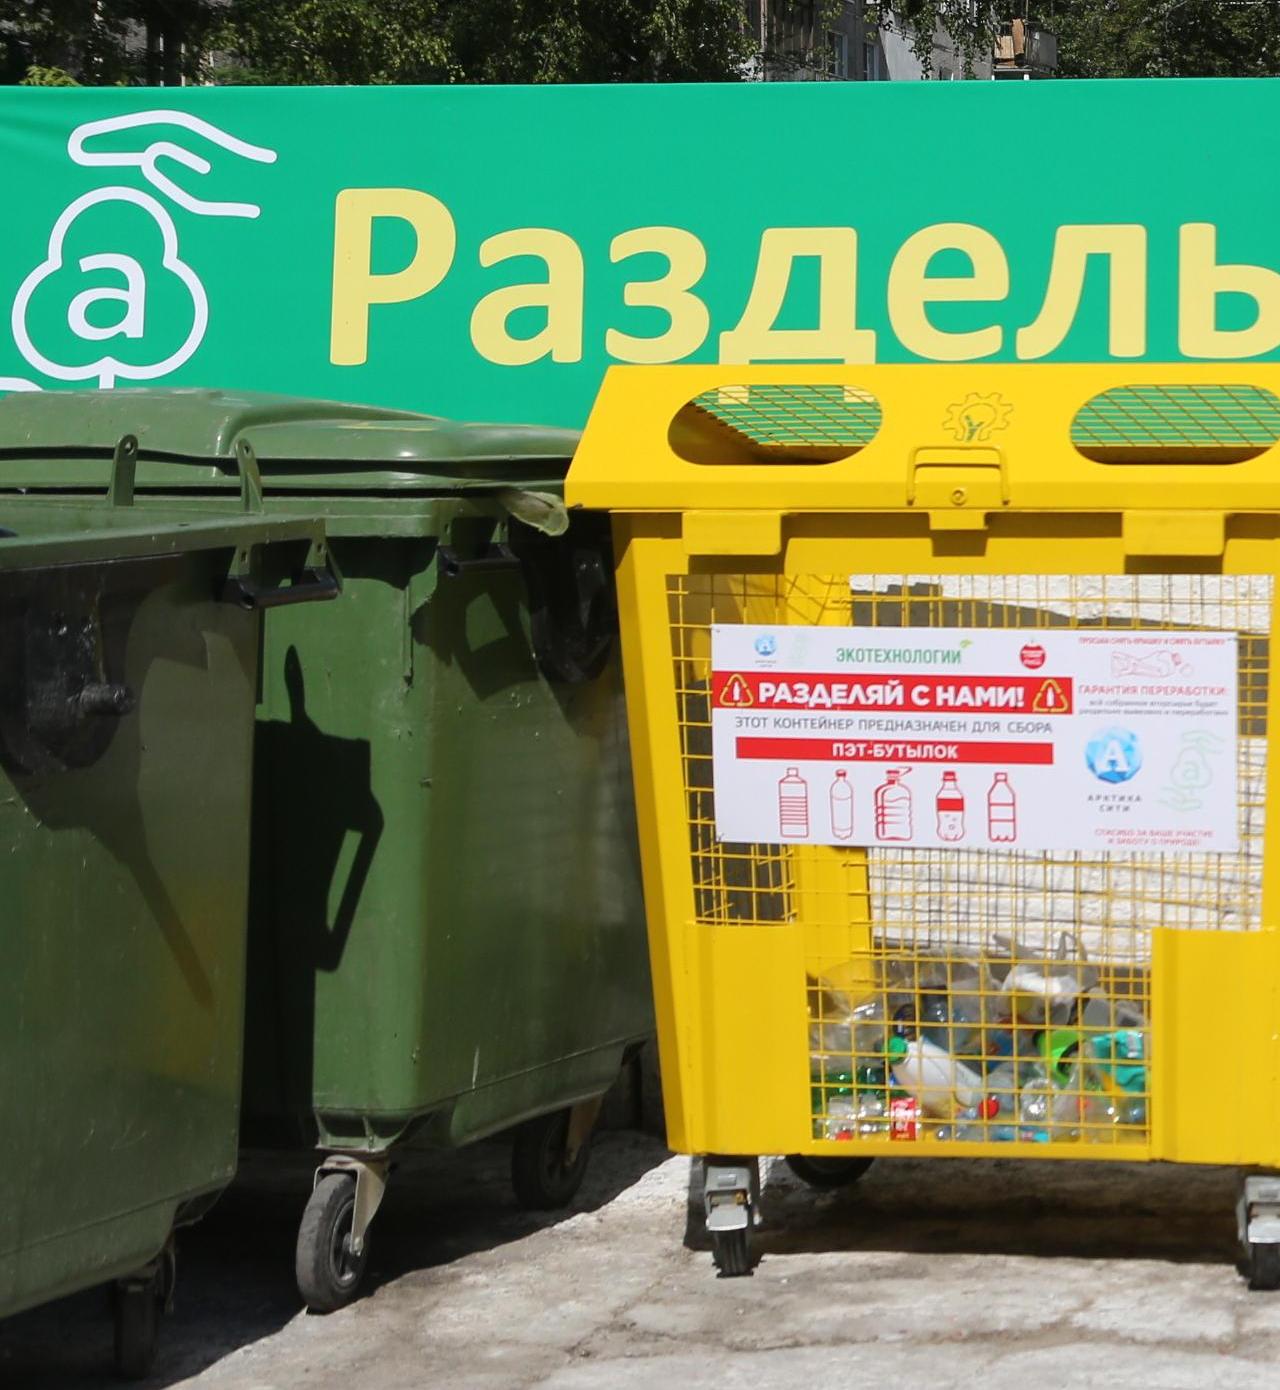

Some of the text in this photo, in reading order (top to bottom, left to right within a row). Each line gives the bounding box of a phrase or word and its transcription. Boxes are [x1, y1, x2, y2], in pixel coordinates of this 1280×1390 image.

[836, 647, 962, 664] ЭКОТЕХНОЛОГИИ
[758, 680, 1025, 709] РАЗДЕЛЯЙ С НАМИ!
[1078, 685, 1137, 695] ГАРАНТИЯ
[735, 715, 1053, 735] ЭТОТ КОНТЕЙНЕР ПРЕДНАЗНАЧЕН ДЛЯ СБОРА
[832, 742, 958, 759] ПЭТ-БУТЫЛОК
